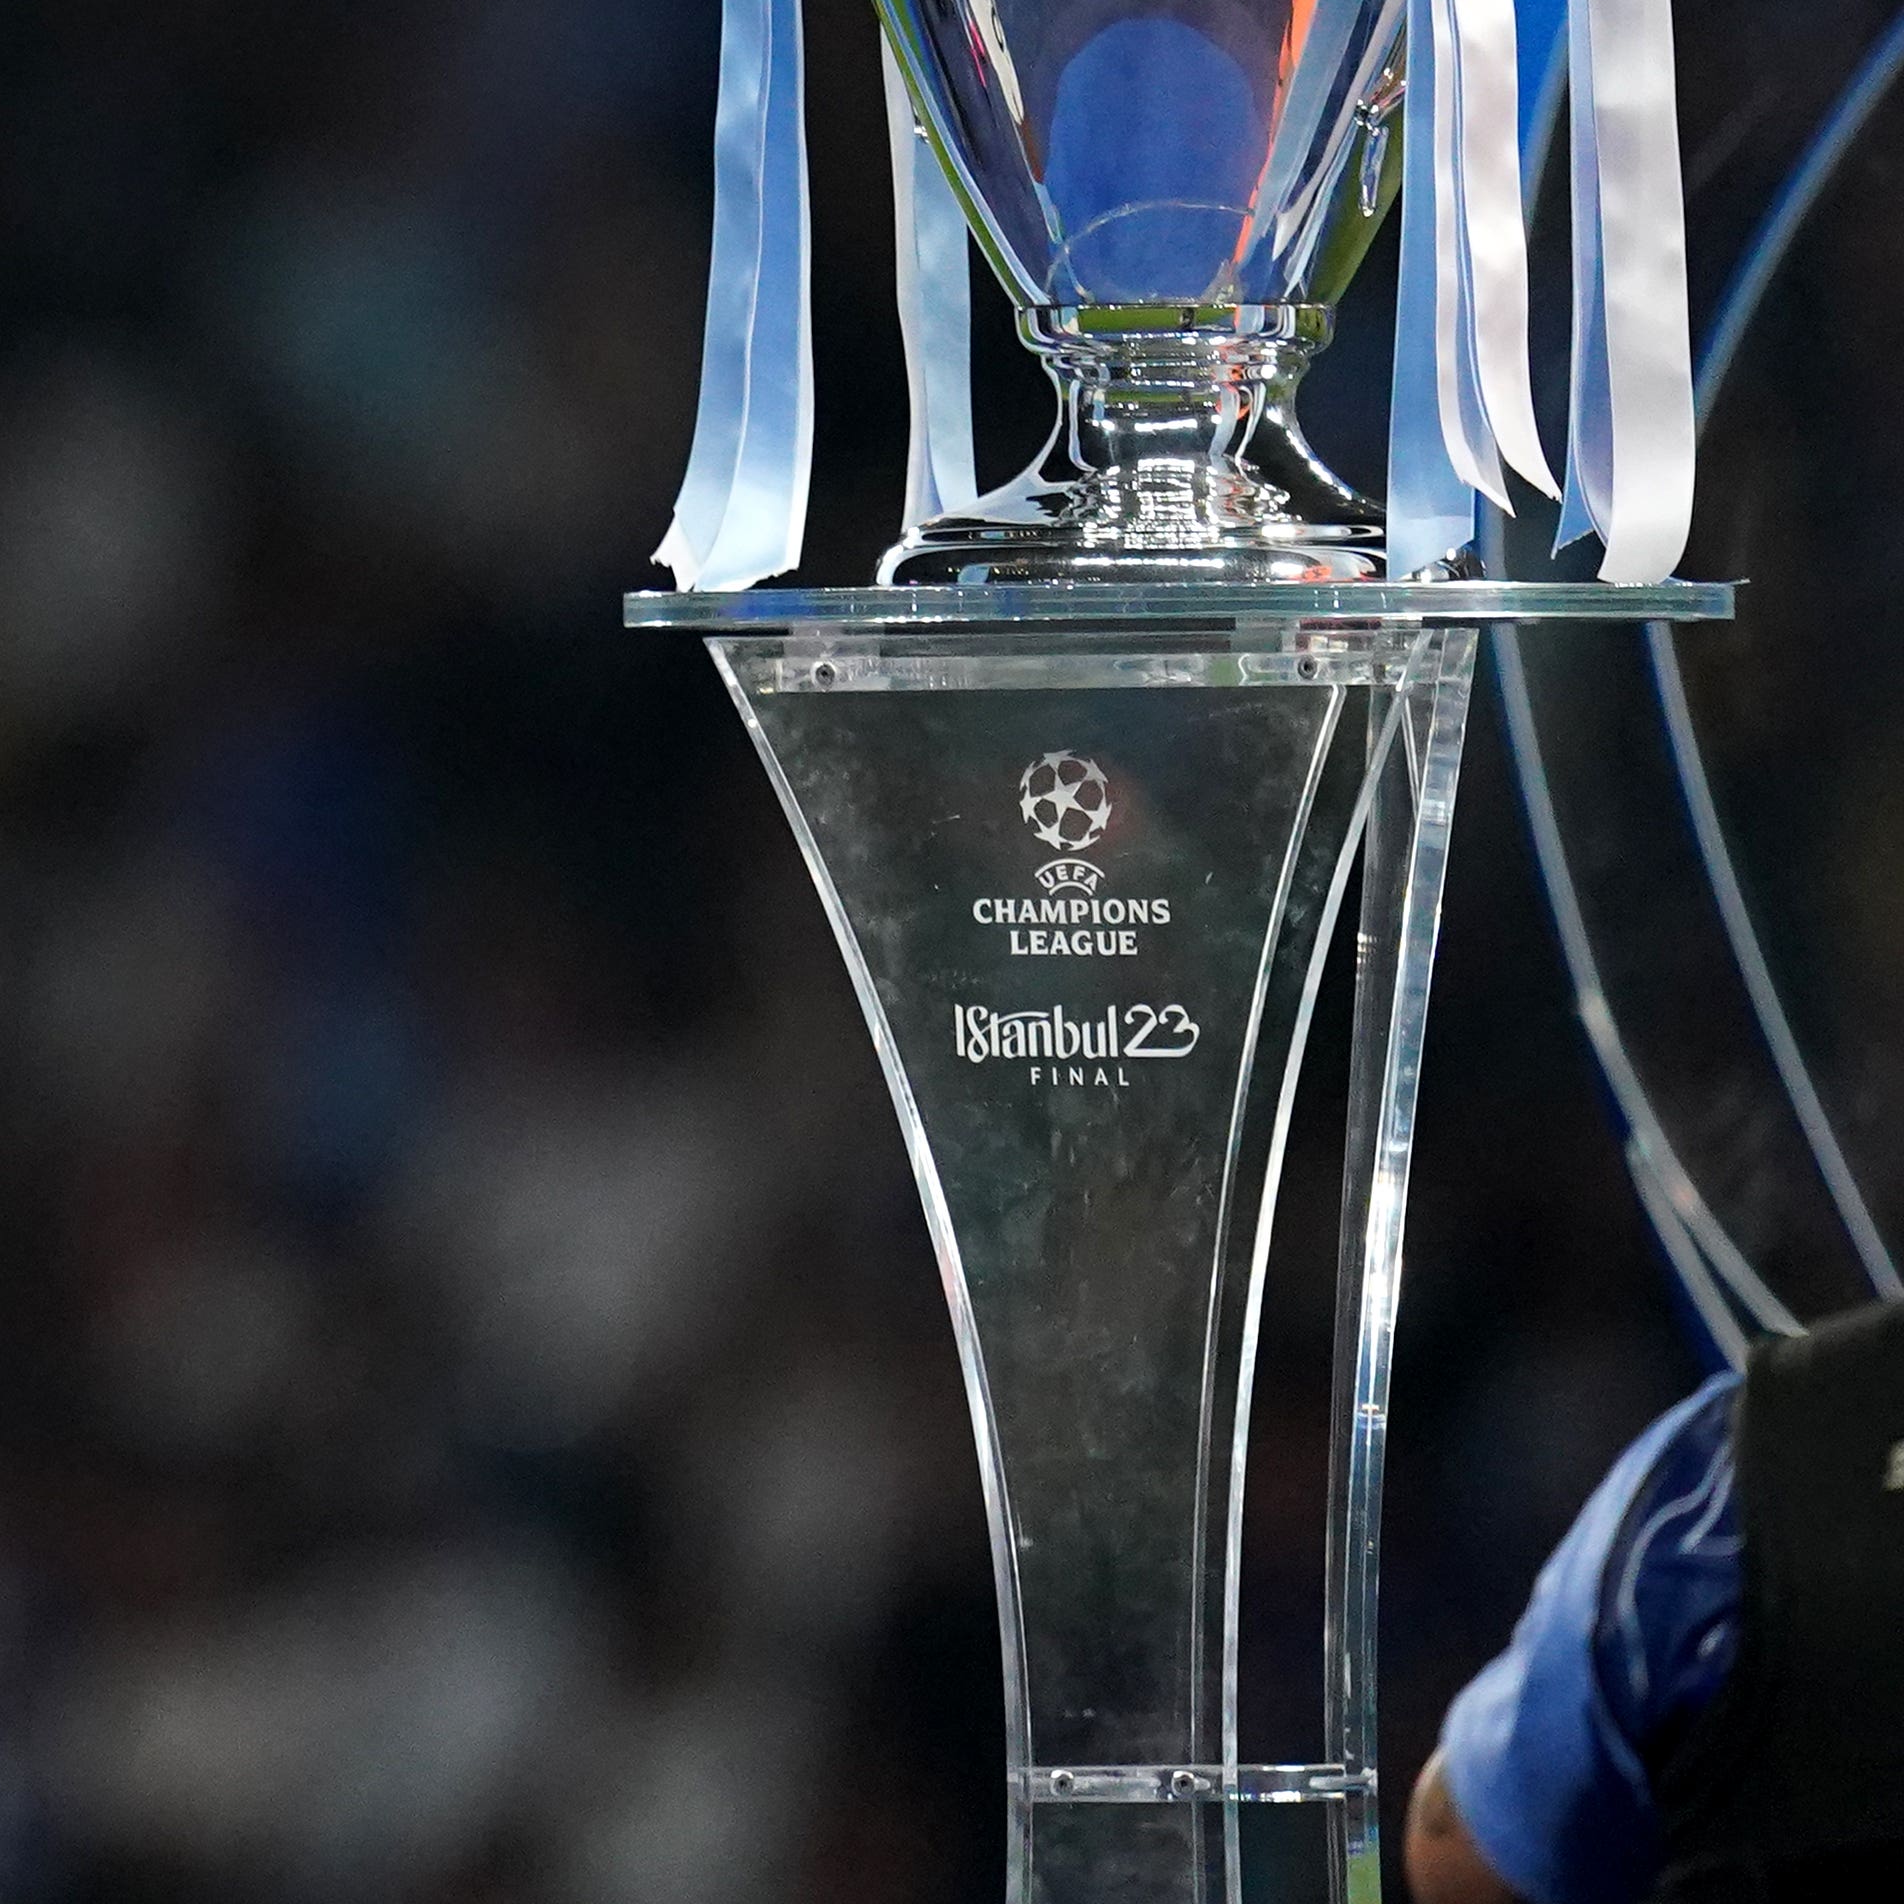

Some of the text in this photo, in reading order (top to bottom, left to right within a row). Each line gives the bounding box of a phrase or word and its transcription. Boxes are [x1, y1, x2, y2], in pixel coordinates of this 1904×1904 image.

[1038, 864, 1101, 892] UEFA
[972, 897, 1172, 925] CHAMPIONS
[1009, 930, 1139, 957] LEAGUE
[1030, 1067, 1130, 1087] FINAL
